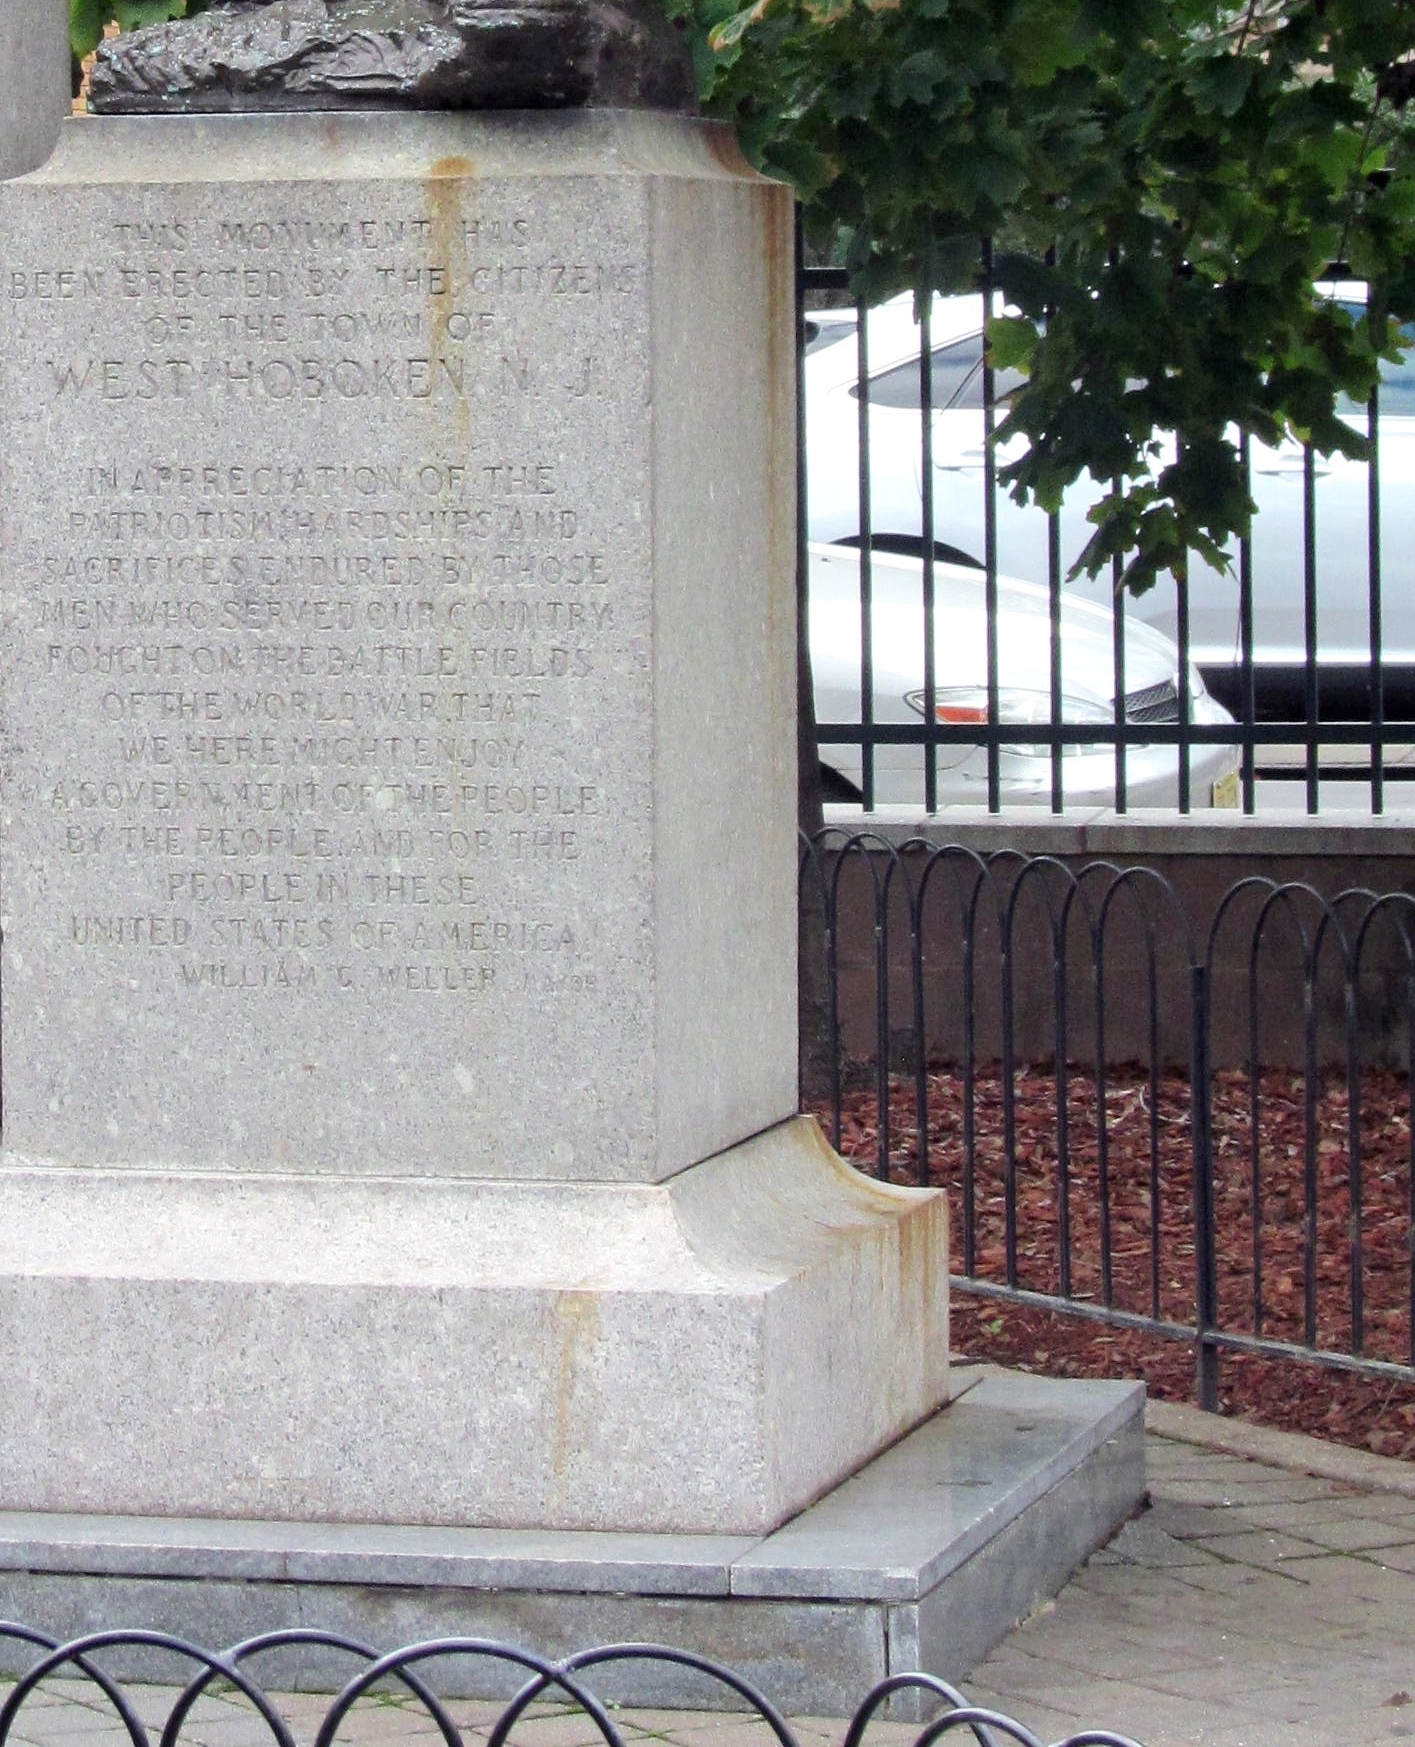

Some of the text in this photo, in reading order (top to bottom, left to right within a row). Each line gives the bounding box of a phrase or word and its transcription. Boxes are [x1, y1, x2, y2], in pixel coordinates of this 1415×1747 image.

[113, 217, 529, 249] THIS MONUMENT HAS
[8, 263, 633, 299] BEEN ERECTED BY THE CITIZENS
[143, 311, 494, 344] OF THE TOWN OF
[45, 359, 191, 399] WEST
[224, 357, 465, 399] HOBOKEN
[85, 465, 557, 496] IN APPRECIATION OF THE
[40, 554, 610, 585] SACRIFICES ENDURED BY THOSE
[119, 736, 525, 767] WE HERE MIGHT ENJOY
[167, 873, 475, 904] PEOPLE IN THESE
[70, 916, 190, 946] UNITED
[210, 918, 334, 947] STATES
[352, 920, 396, 949] OF
